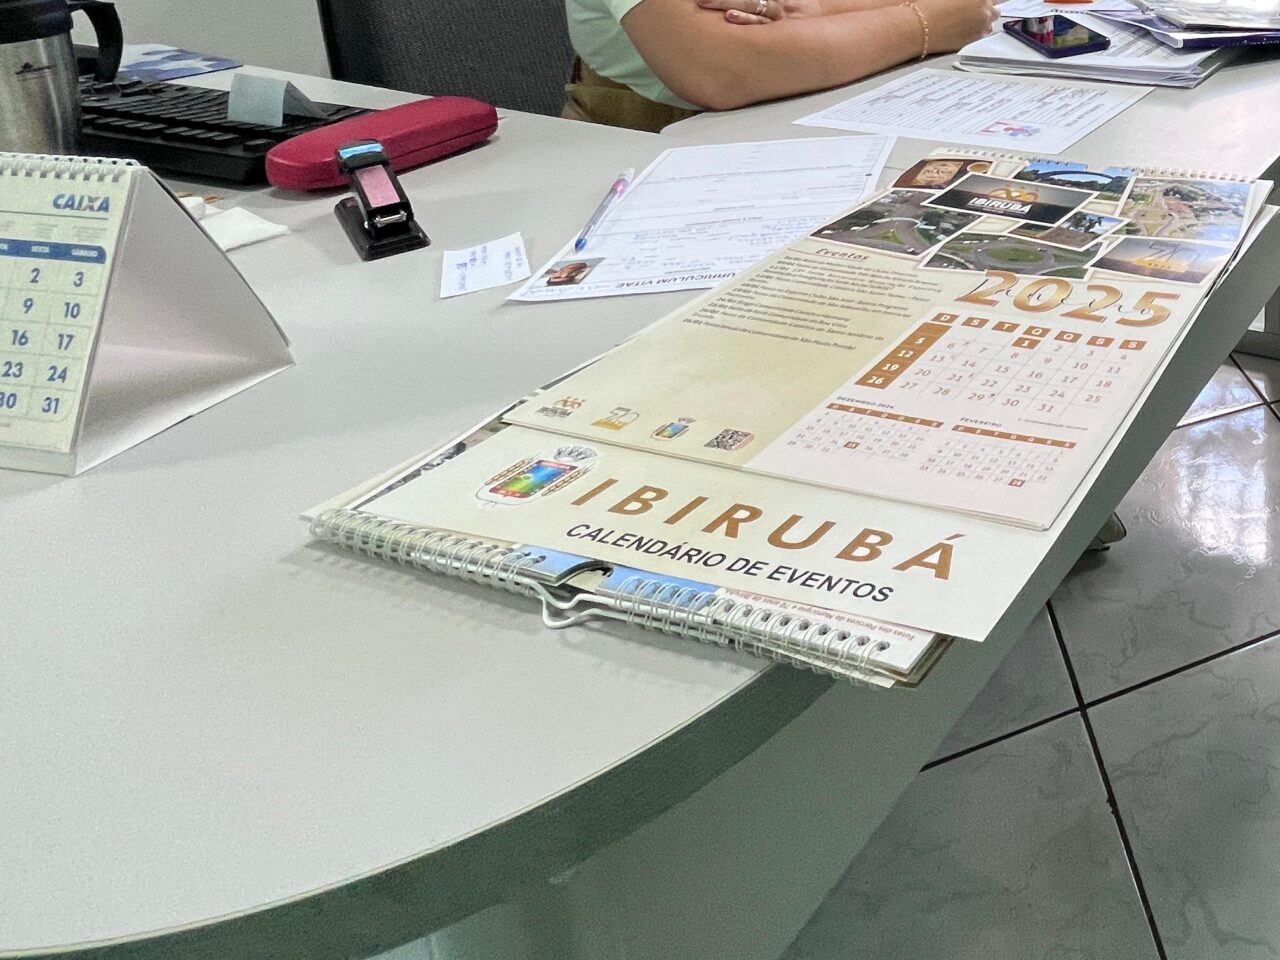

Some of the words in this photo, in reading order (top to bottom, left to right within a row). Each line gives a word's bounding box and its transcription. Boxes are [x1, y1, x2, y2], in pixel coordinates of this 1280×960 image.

[52, 193, 111, 213] CAIXA
[815, 247, 870, 261] Eventos
[30, 267, 40, 283] 2
[73, 271, 84, 287] 3
[655, 271, 737, 286] URRICULUM
[23, 297, 34, 314] 9
[64, 302, 81, 319] 10
[955, 269, 1182, 329] 2025
[11, 329, 29, 346] 16
[57, 333, 75, 350] 17
[1, 360, 24, 378] 23
[47, 365, 68, 383] 24
[897, 350, 914, 358] 12
[960, 360, 976, 368] 14
[994, 365, 1010, 373] 15
[1028, 370, 1044, 379] 16
[1061, 376, 1078, 384] 17
[1096, 380, 1112, 388] 18
[1072, 362, 1088, 370] 10
[1106, 366, 1121, 374] 11
[881, 363, 900, 371] 19
[914, 368, 931, 376] 20
[947, 373, 963, 382] 21
[981, 379, 998, 387] 22
[1015, 384, 1031, 393] 23
[1049, 389, 1065, 398] 24
[1085, 394, 1102, 403] 25
[866, 375, 885, 384] 26
[899, 381, 918, 389] 27
[933, 386, 951, 396] 28
[967, 392, 985, 401] 29
[1001, 398, 1019, 407] 30
[1038, 403, 1054, 413] 31
[42, 397, 60, 414] 31
[960, 417, 1002, 427] FEVEREIRO
[570, 478, 966, 580] IBIRUBÁ
[566, 523, 728, 568] CALENDÁRIO
[725, 556, 764, 578] DE
[766, 564, 895, 603] EVENTOS
[895, 629, 916, 641] Fotos
